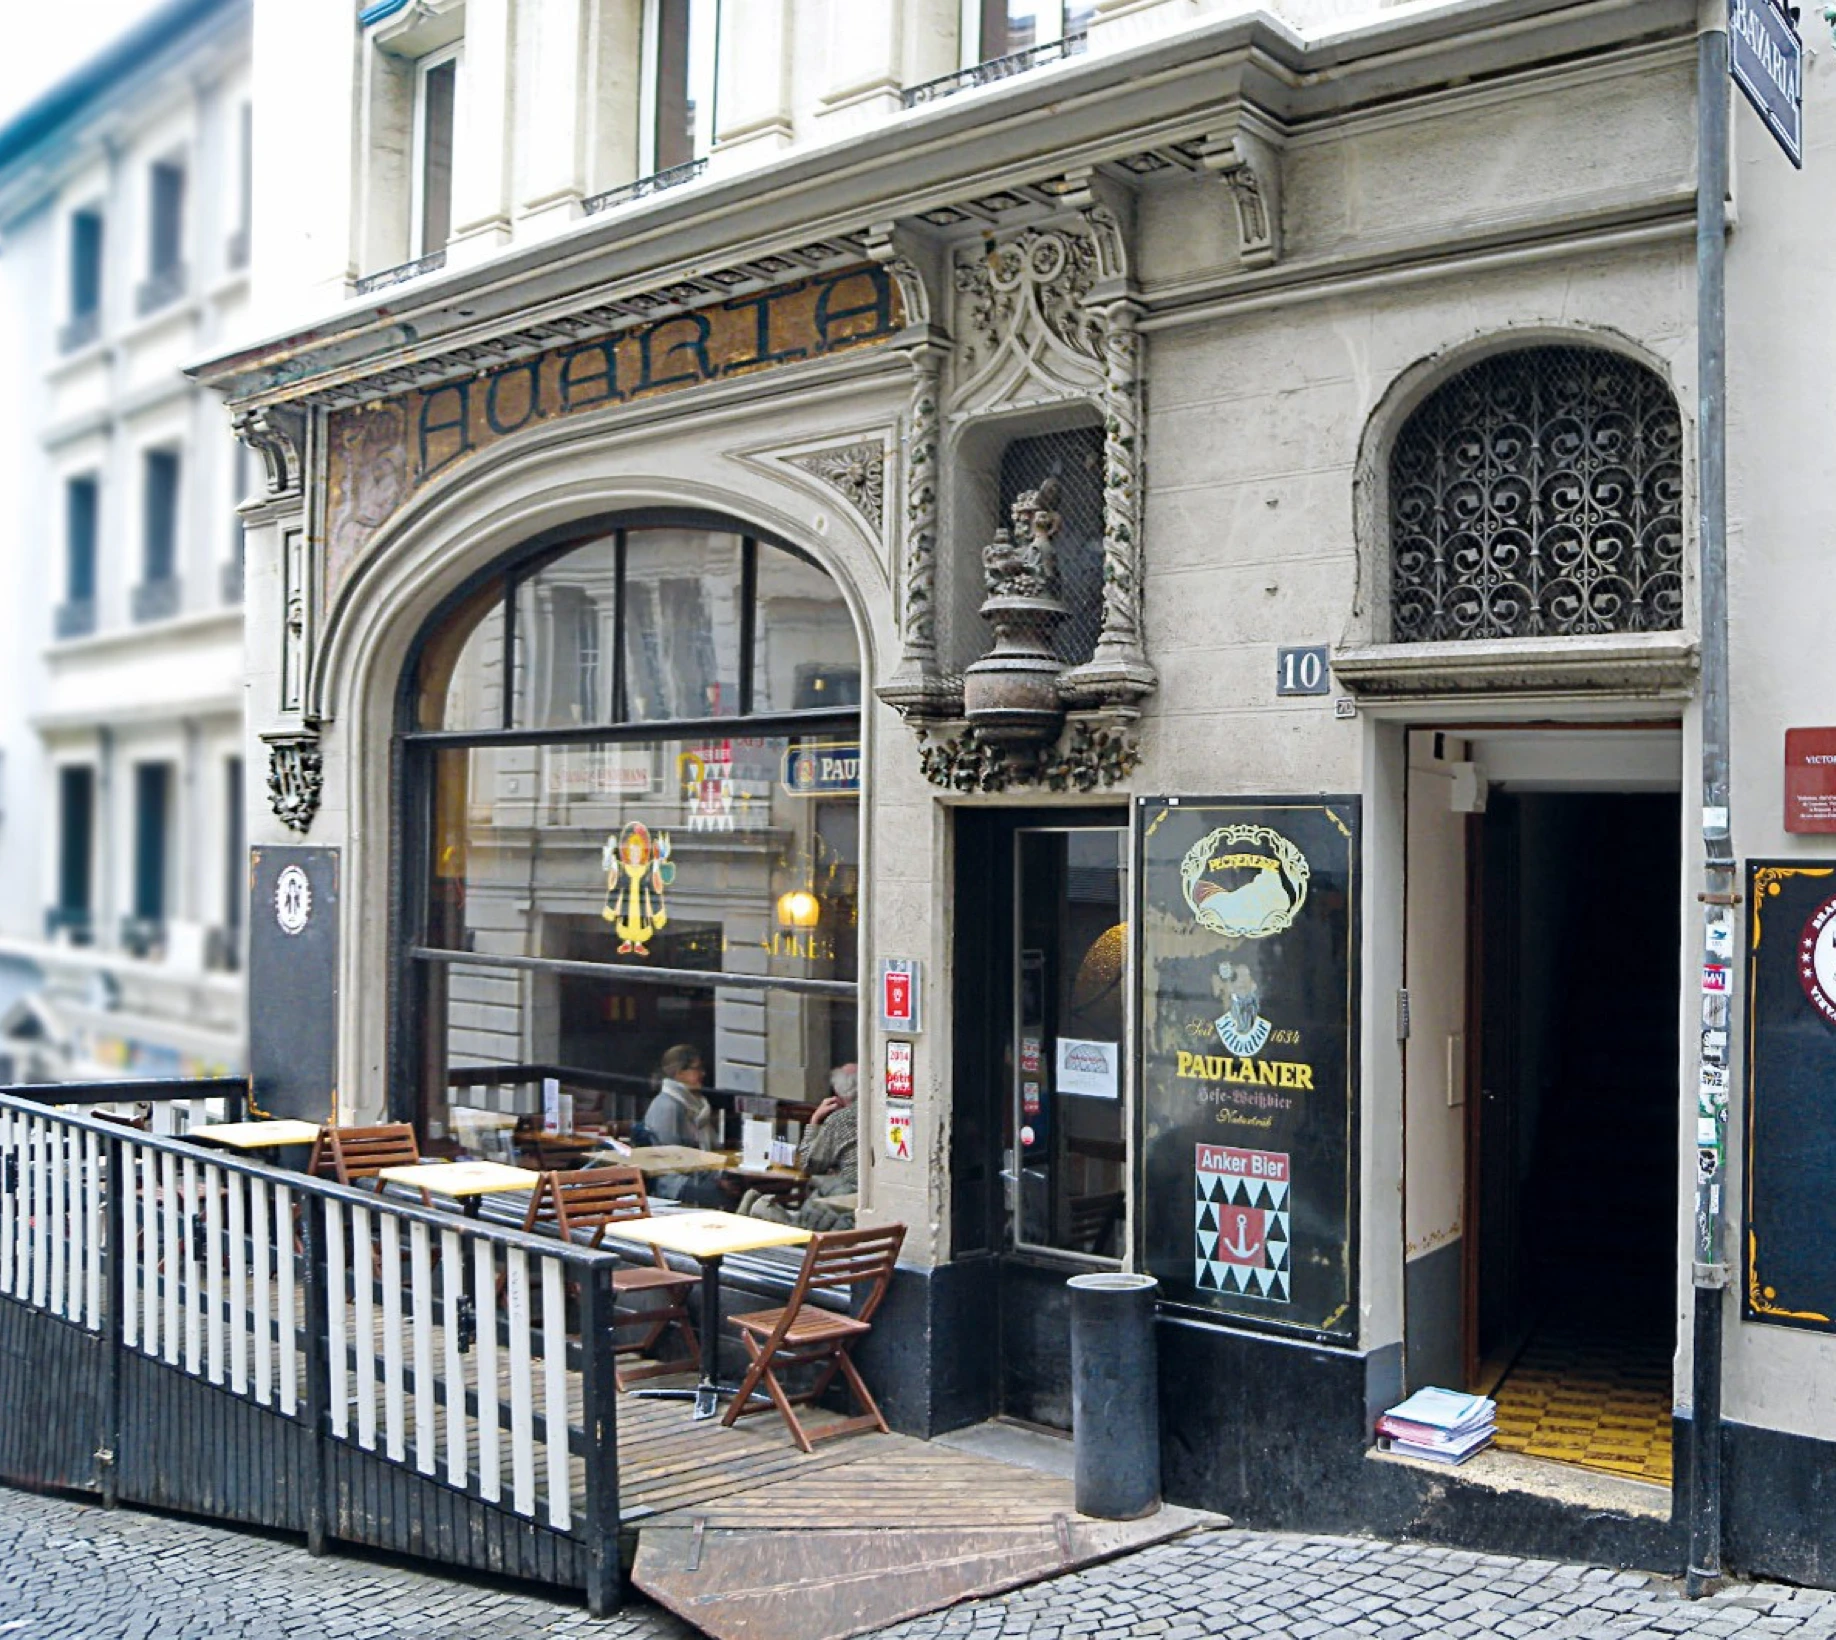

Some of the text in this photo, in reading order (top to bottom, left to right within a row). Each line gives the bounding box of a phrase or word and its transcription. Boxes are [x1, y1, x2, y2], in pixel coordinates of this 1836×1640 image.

[1733, 0, 1797, 113] BAVARIA
[1283, 652, 1321, 689] 10
[1270, 1029, 1300, 1044] 1634
[1176, 1051, 1314, 1090] PAULANER
[1201, 1149, 1284, 1178] Anker Bier
